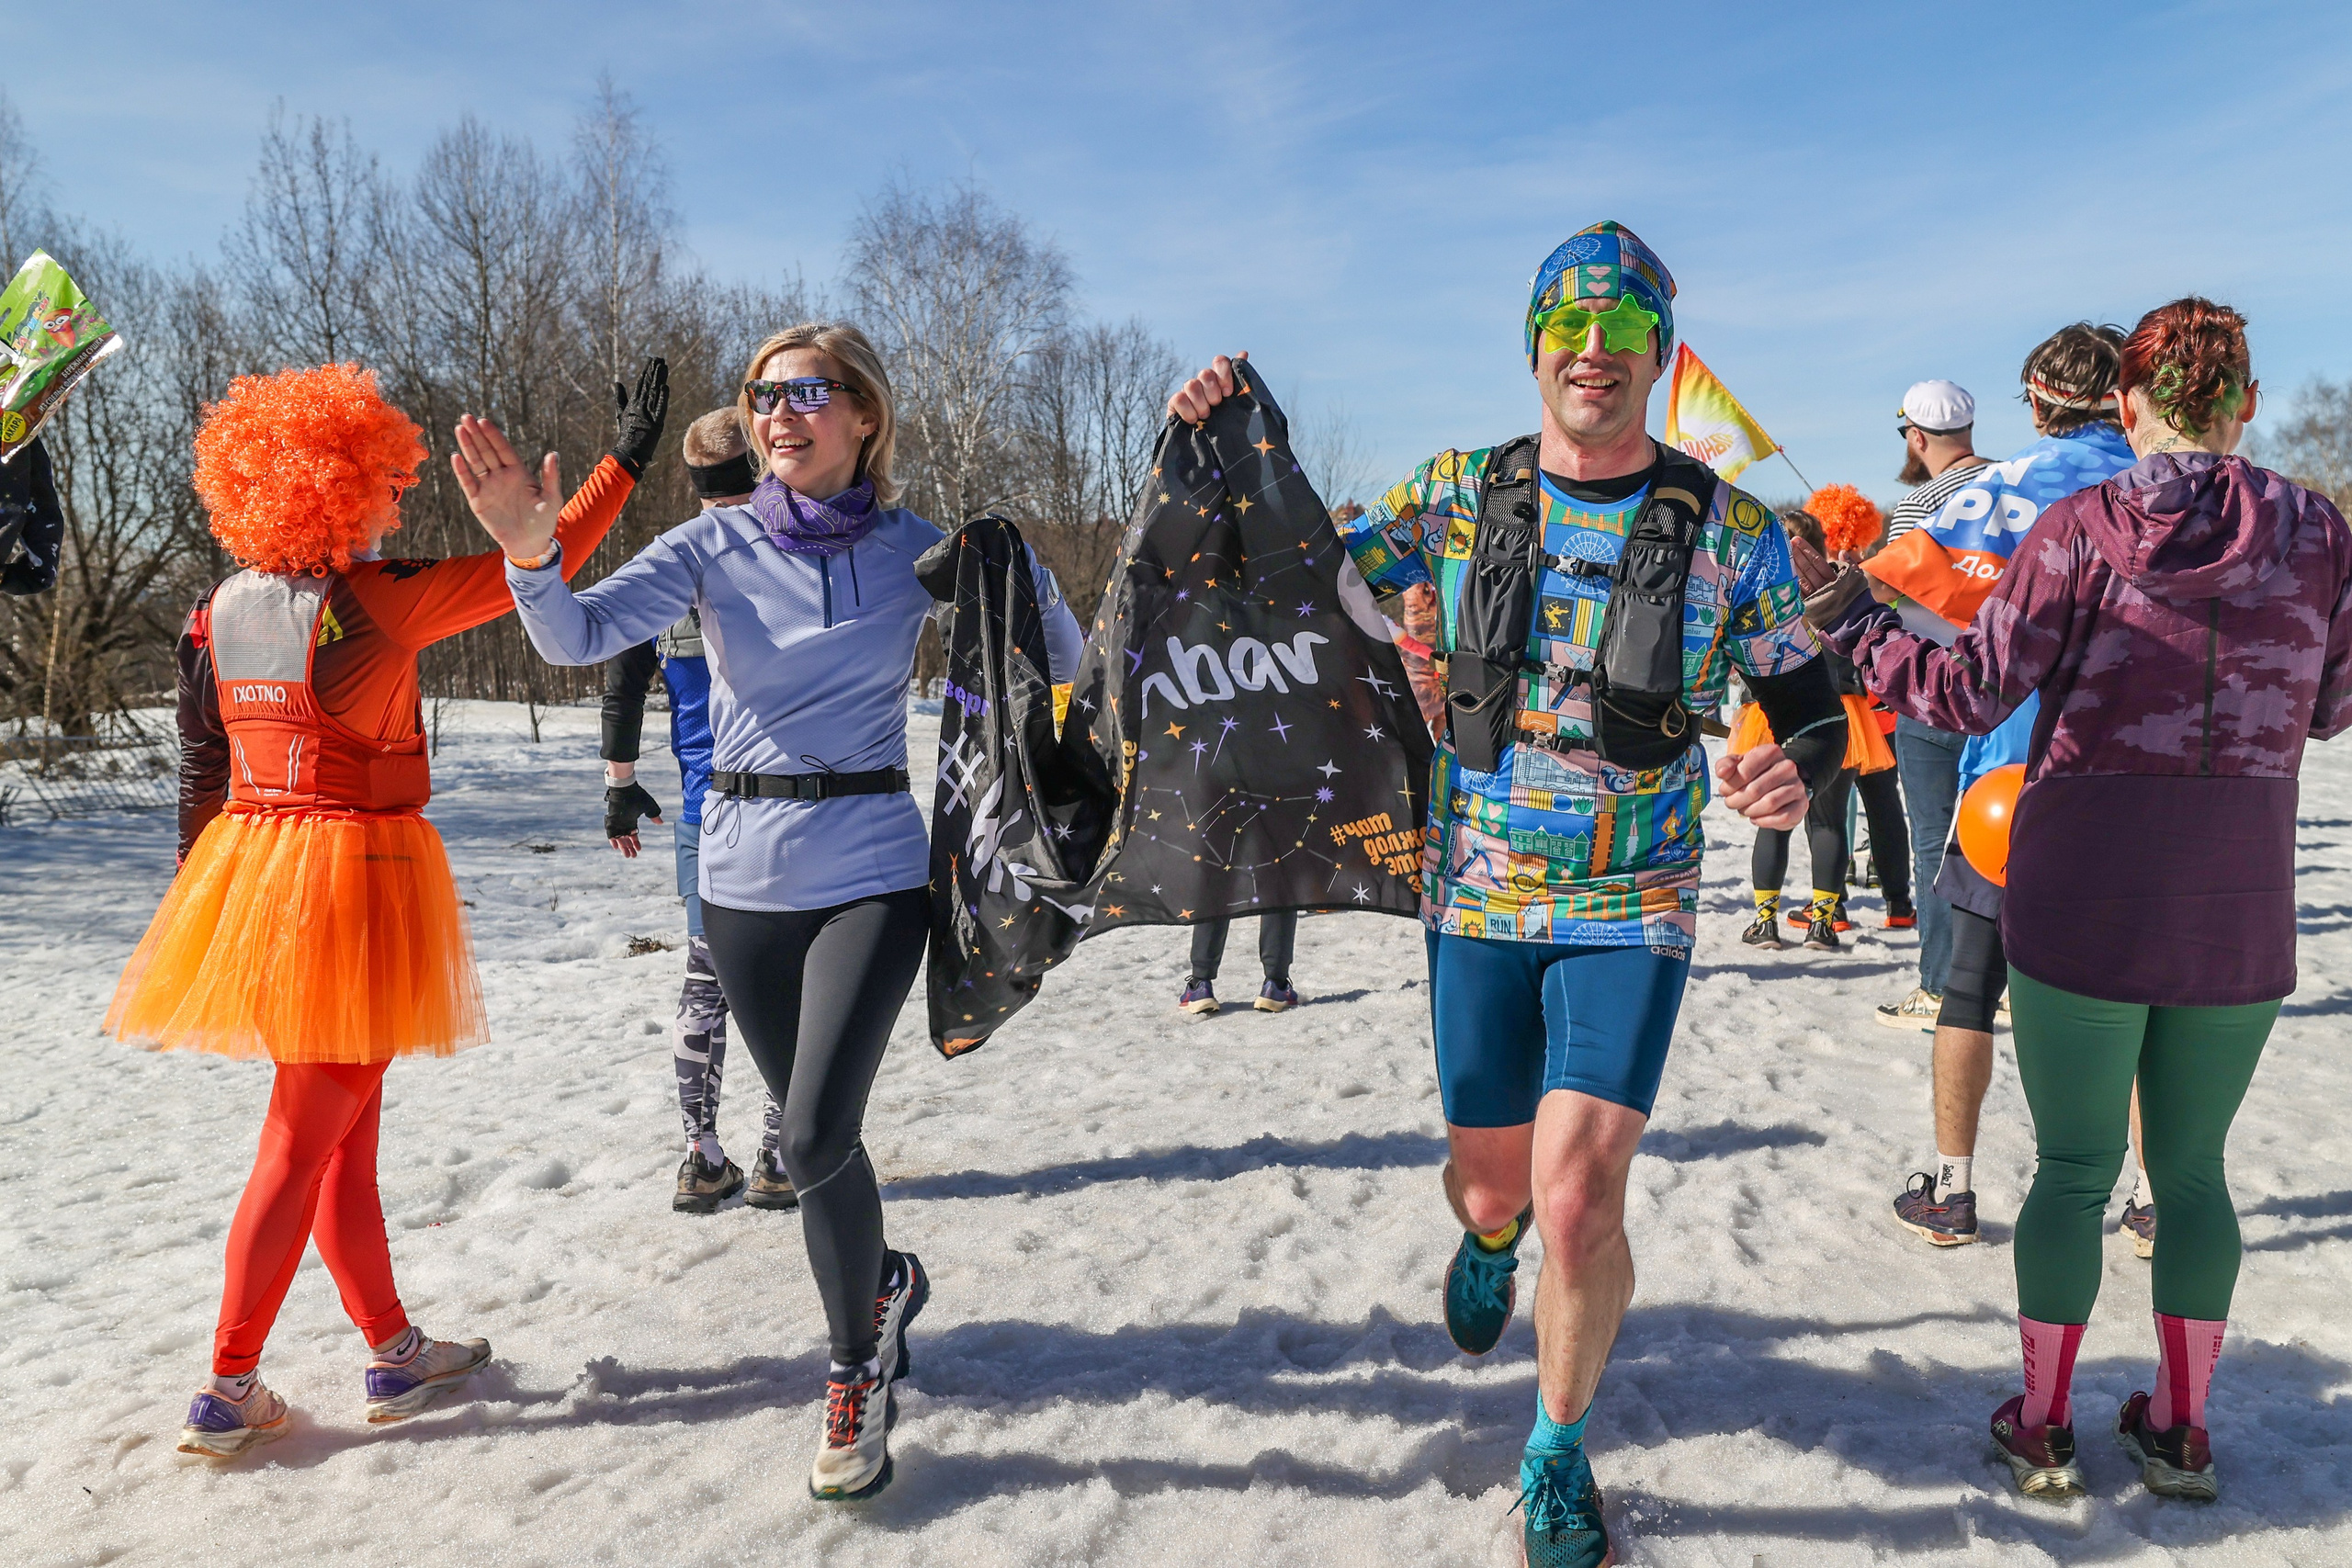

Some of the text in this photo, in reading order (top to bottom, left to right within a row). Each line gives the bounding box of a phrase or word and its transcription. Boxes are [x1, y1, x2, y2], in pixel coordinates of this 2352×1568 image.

[61, 354, 88, 378] БЕРЕЖНАЯ
[85, 337, 105, 358] СУШКА
[46, 386, 66, 410] СПЕЛЫХ
[4, 415, 24, 443] САХАРА
[1330, 812, 1392, 847] #чат
[1650, 945, 1686, 962] adidas
